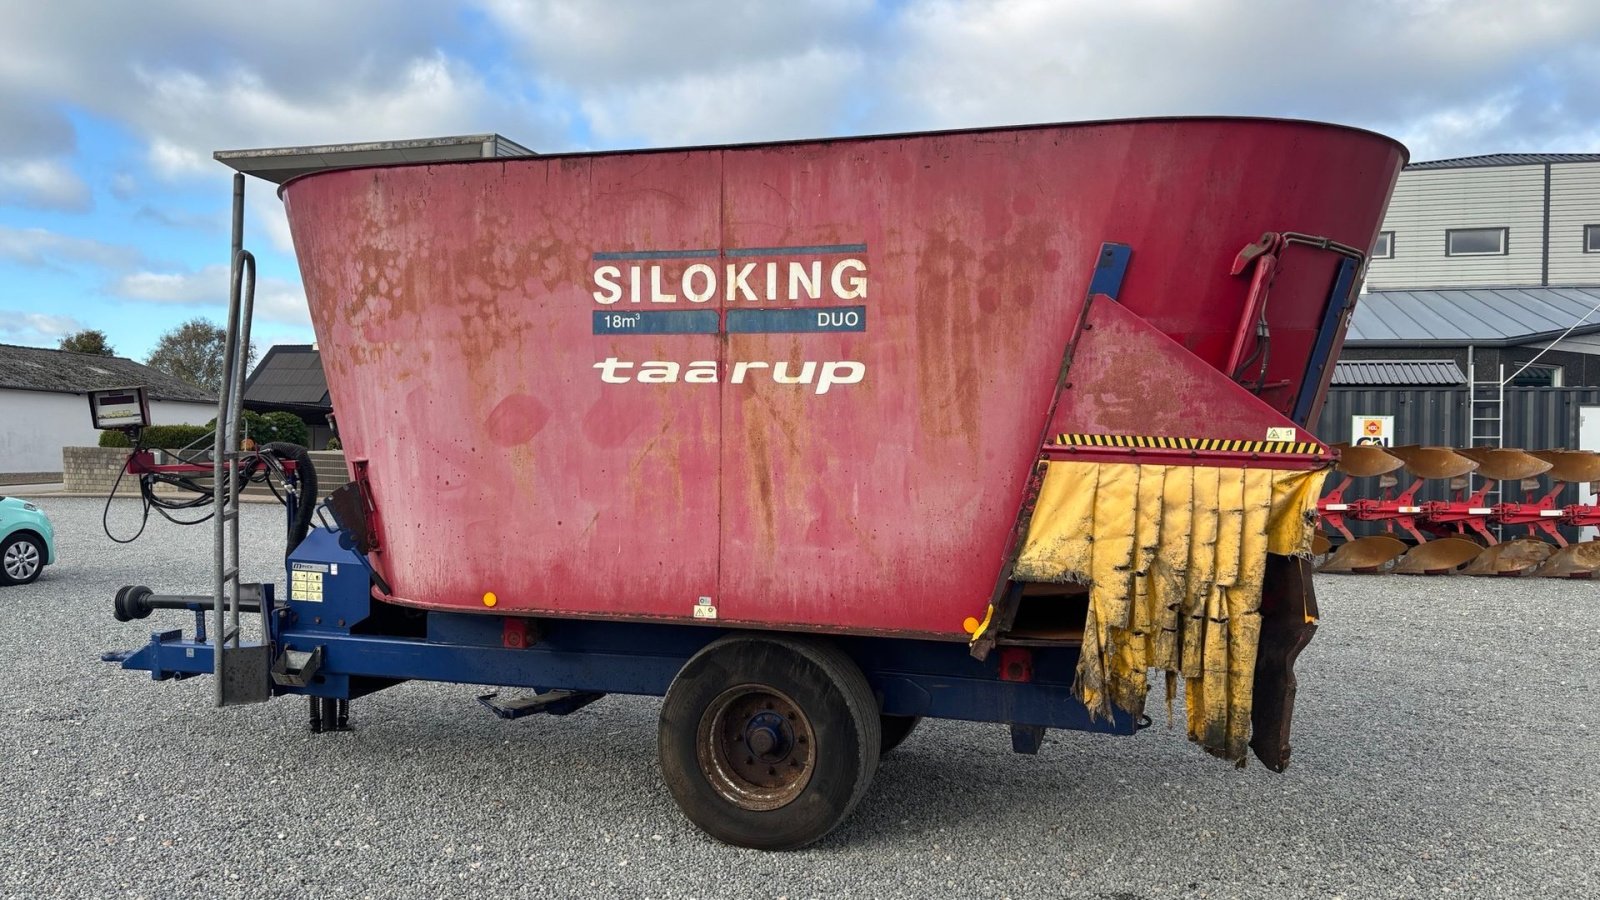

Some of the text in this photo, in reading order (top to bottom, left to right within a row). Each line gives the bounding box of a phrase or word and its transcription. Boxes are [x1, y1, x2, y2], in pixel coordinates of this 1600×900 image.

[592, 258, 867, 305] SILOKING
[817, 311, 859, 328] DUO
[592, 357, 866, 395] taarup
